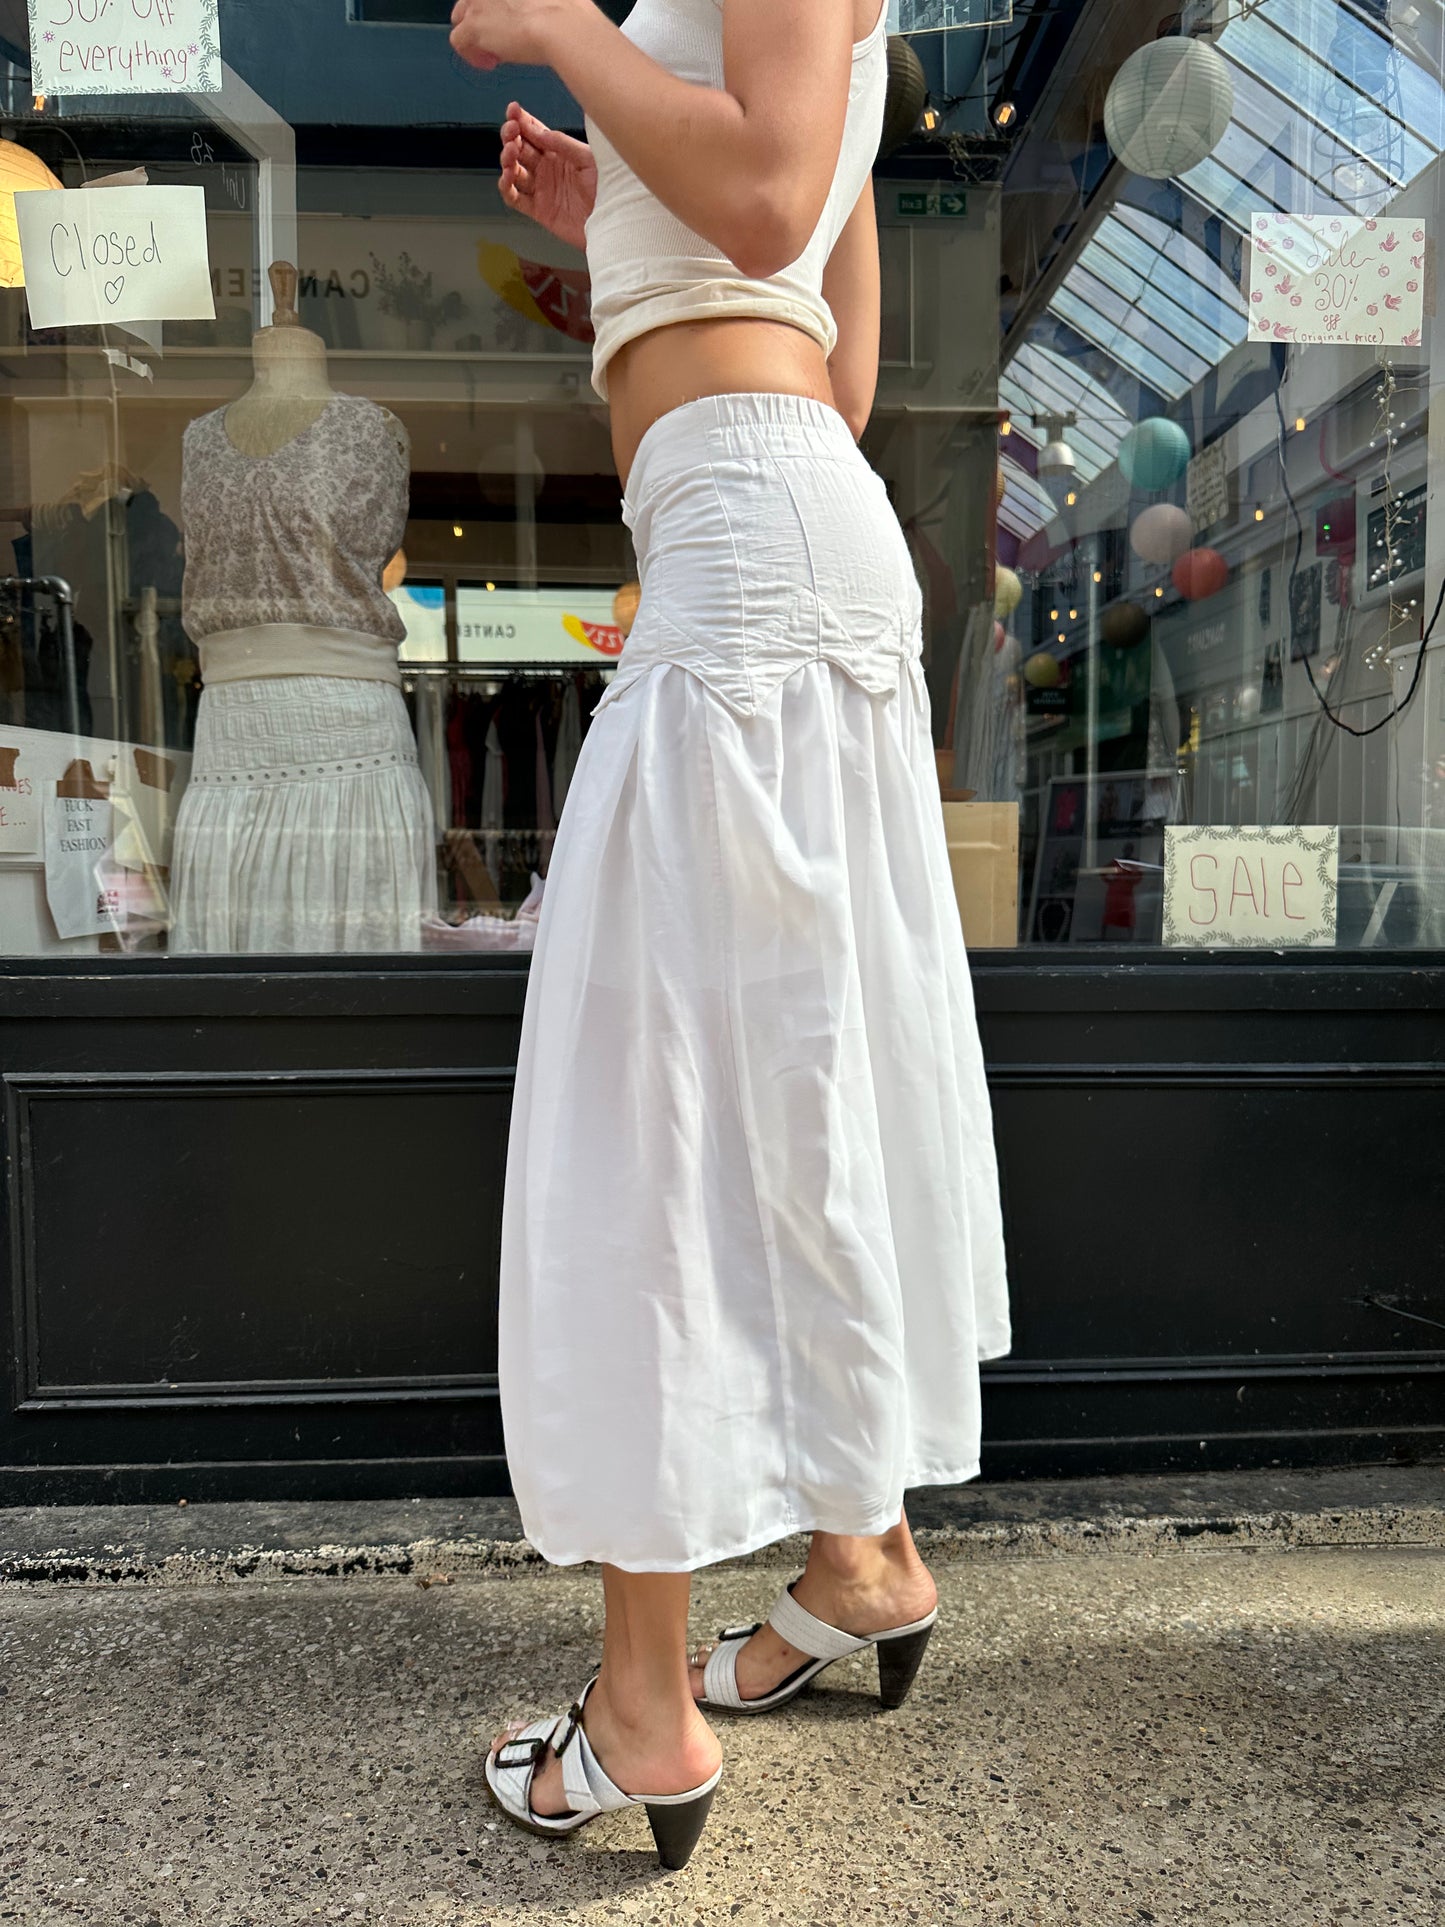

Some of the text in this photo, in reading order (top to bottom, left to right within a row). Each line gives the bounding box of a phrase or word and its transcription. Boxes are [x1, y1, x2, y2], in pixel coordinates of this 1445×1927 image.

[59, 40, 188, 84] everything
[50, 221, 162, 277] Closed
[1306, 228, 1376, 268] Sale
[1314, 272, 1359, 312] 30%
[1323, 313, 1342, 331] off
[60, 835, 107, 852] FASHION
[67, 819, 93, 832] FAST
